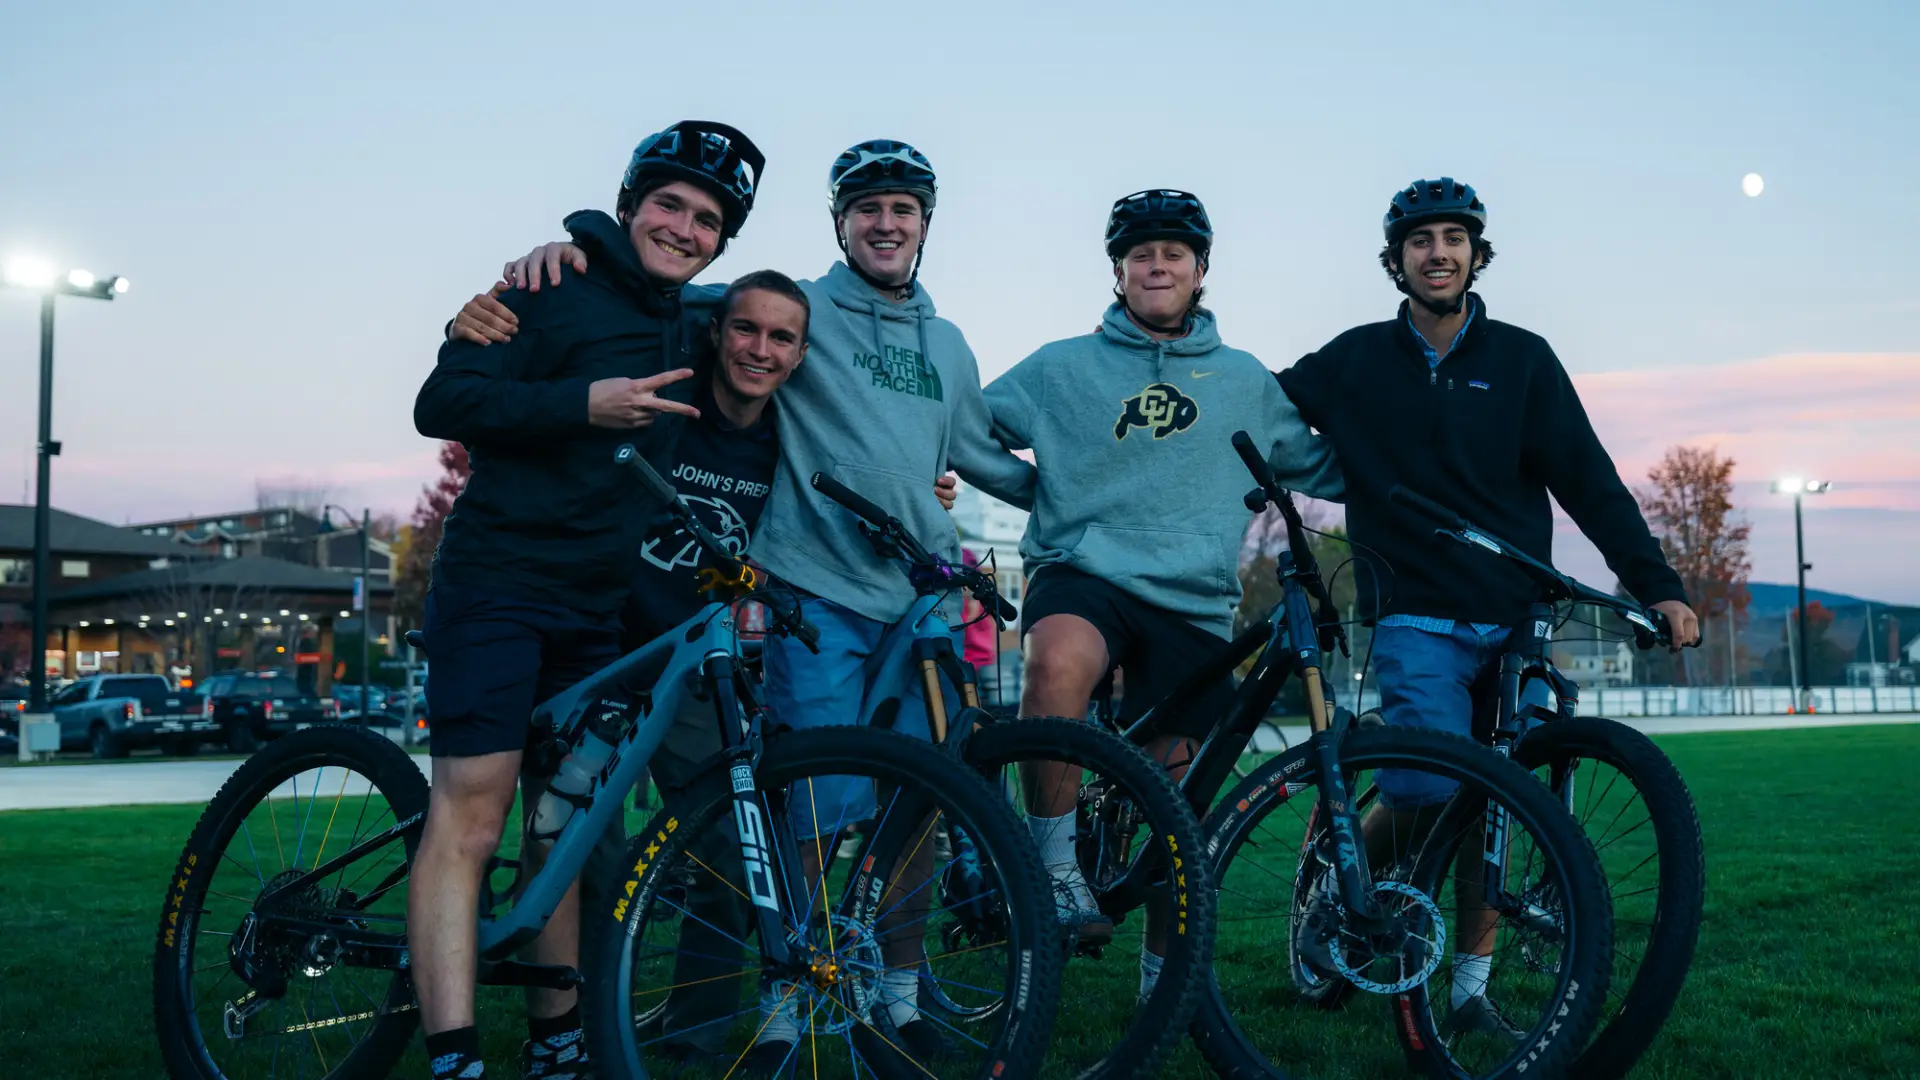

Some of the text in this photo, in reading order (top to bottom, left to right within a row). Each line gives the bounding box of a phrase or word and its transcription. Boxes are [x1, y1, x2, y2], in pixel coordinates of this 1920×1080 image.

[884, 345, 913, 364] THE
[872, 371, 916, 396] FACE
[1139, 389, 1178, 427] CU
[672, 463, 769, 499] JOHN'S PREP
[612, 816, 679, 922] MAXXIS
[1167, 834, 1187, 935] MAXXIS
[163, 852, 198, 948] MAXXIS
[869, 876, 885, 903] DT
[1515, 979, 1580, 1073] MAXXIS
